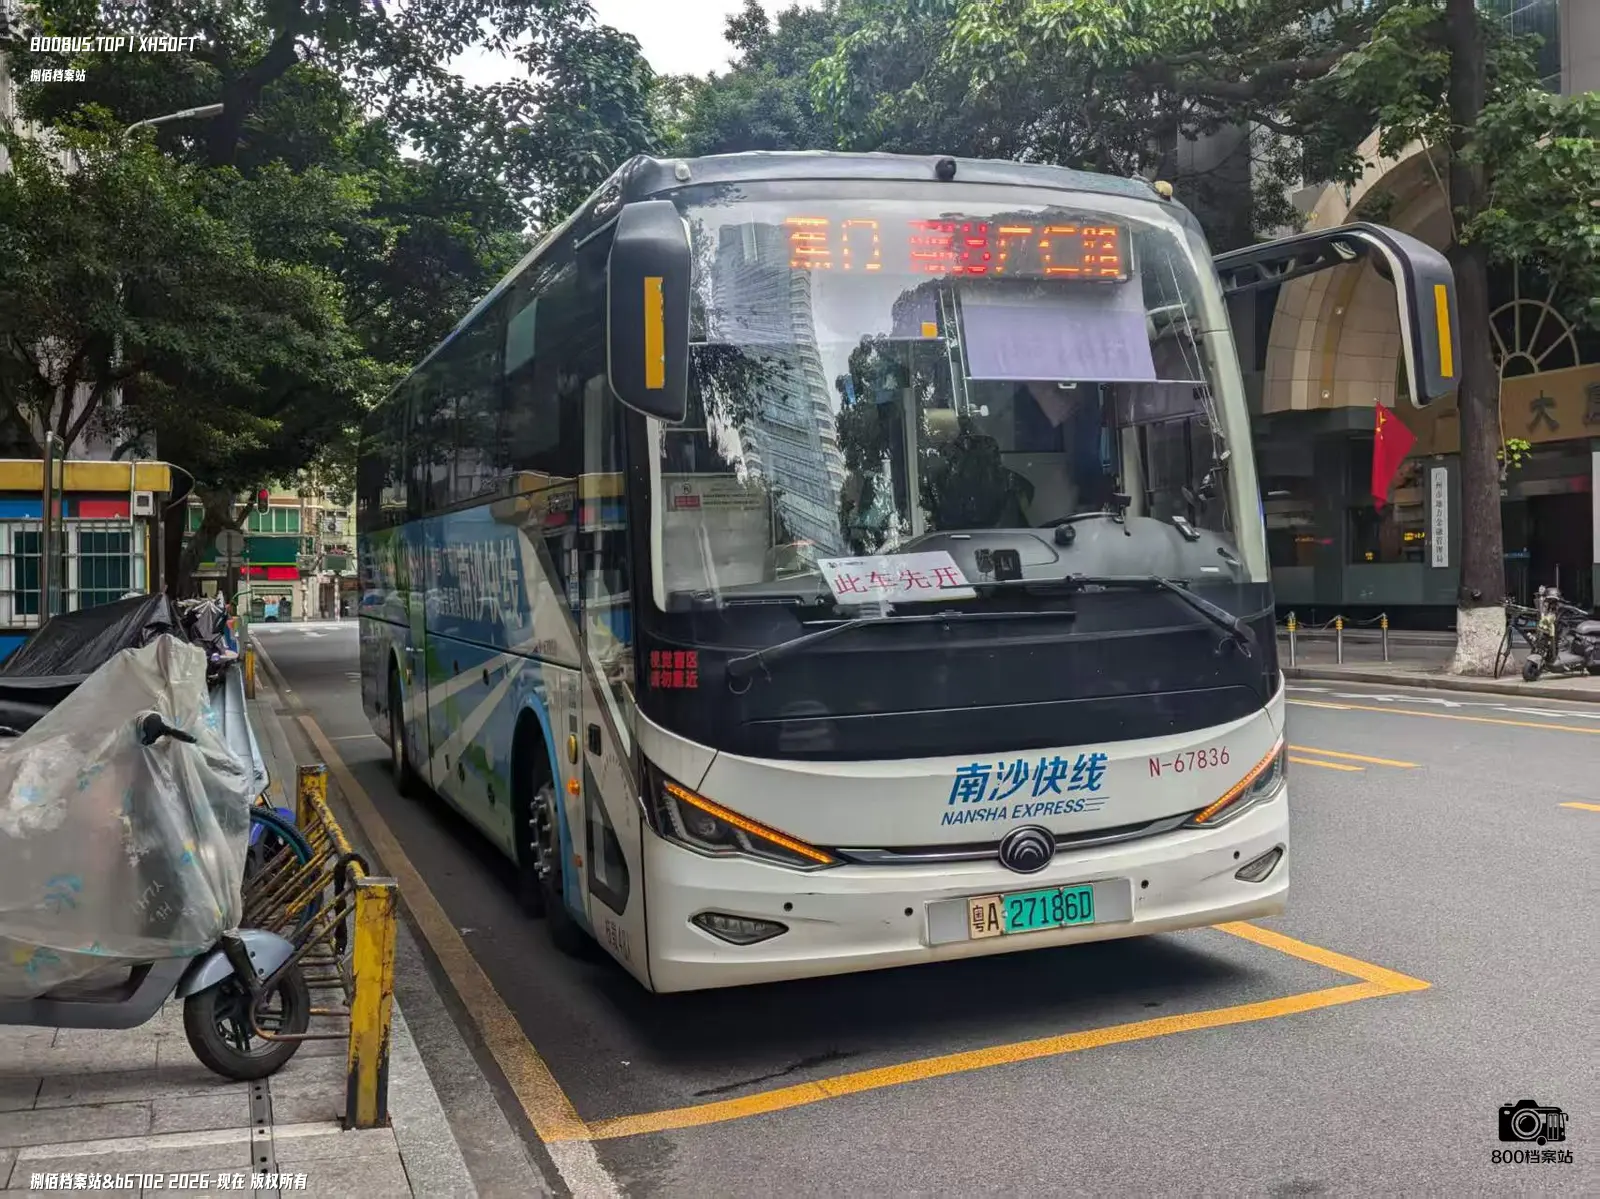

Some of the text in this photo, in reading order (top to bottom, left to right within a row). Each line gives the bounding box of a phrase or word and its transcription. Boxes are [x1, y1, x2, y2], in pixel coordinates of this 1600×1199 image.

[834, 567, 960, 594] 此车先开
[1149, 746, 1231, 778] N-67836
[948, 752, 1108, 805] 南沙快线
[941, 798, 1086, 826] NANSHA EXPRESS
[972, 891, 1092, 933] 粤A 27186D
